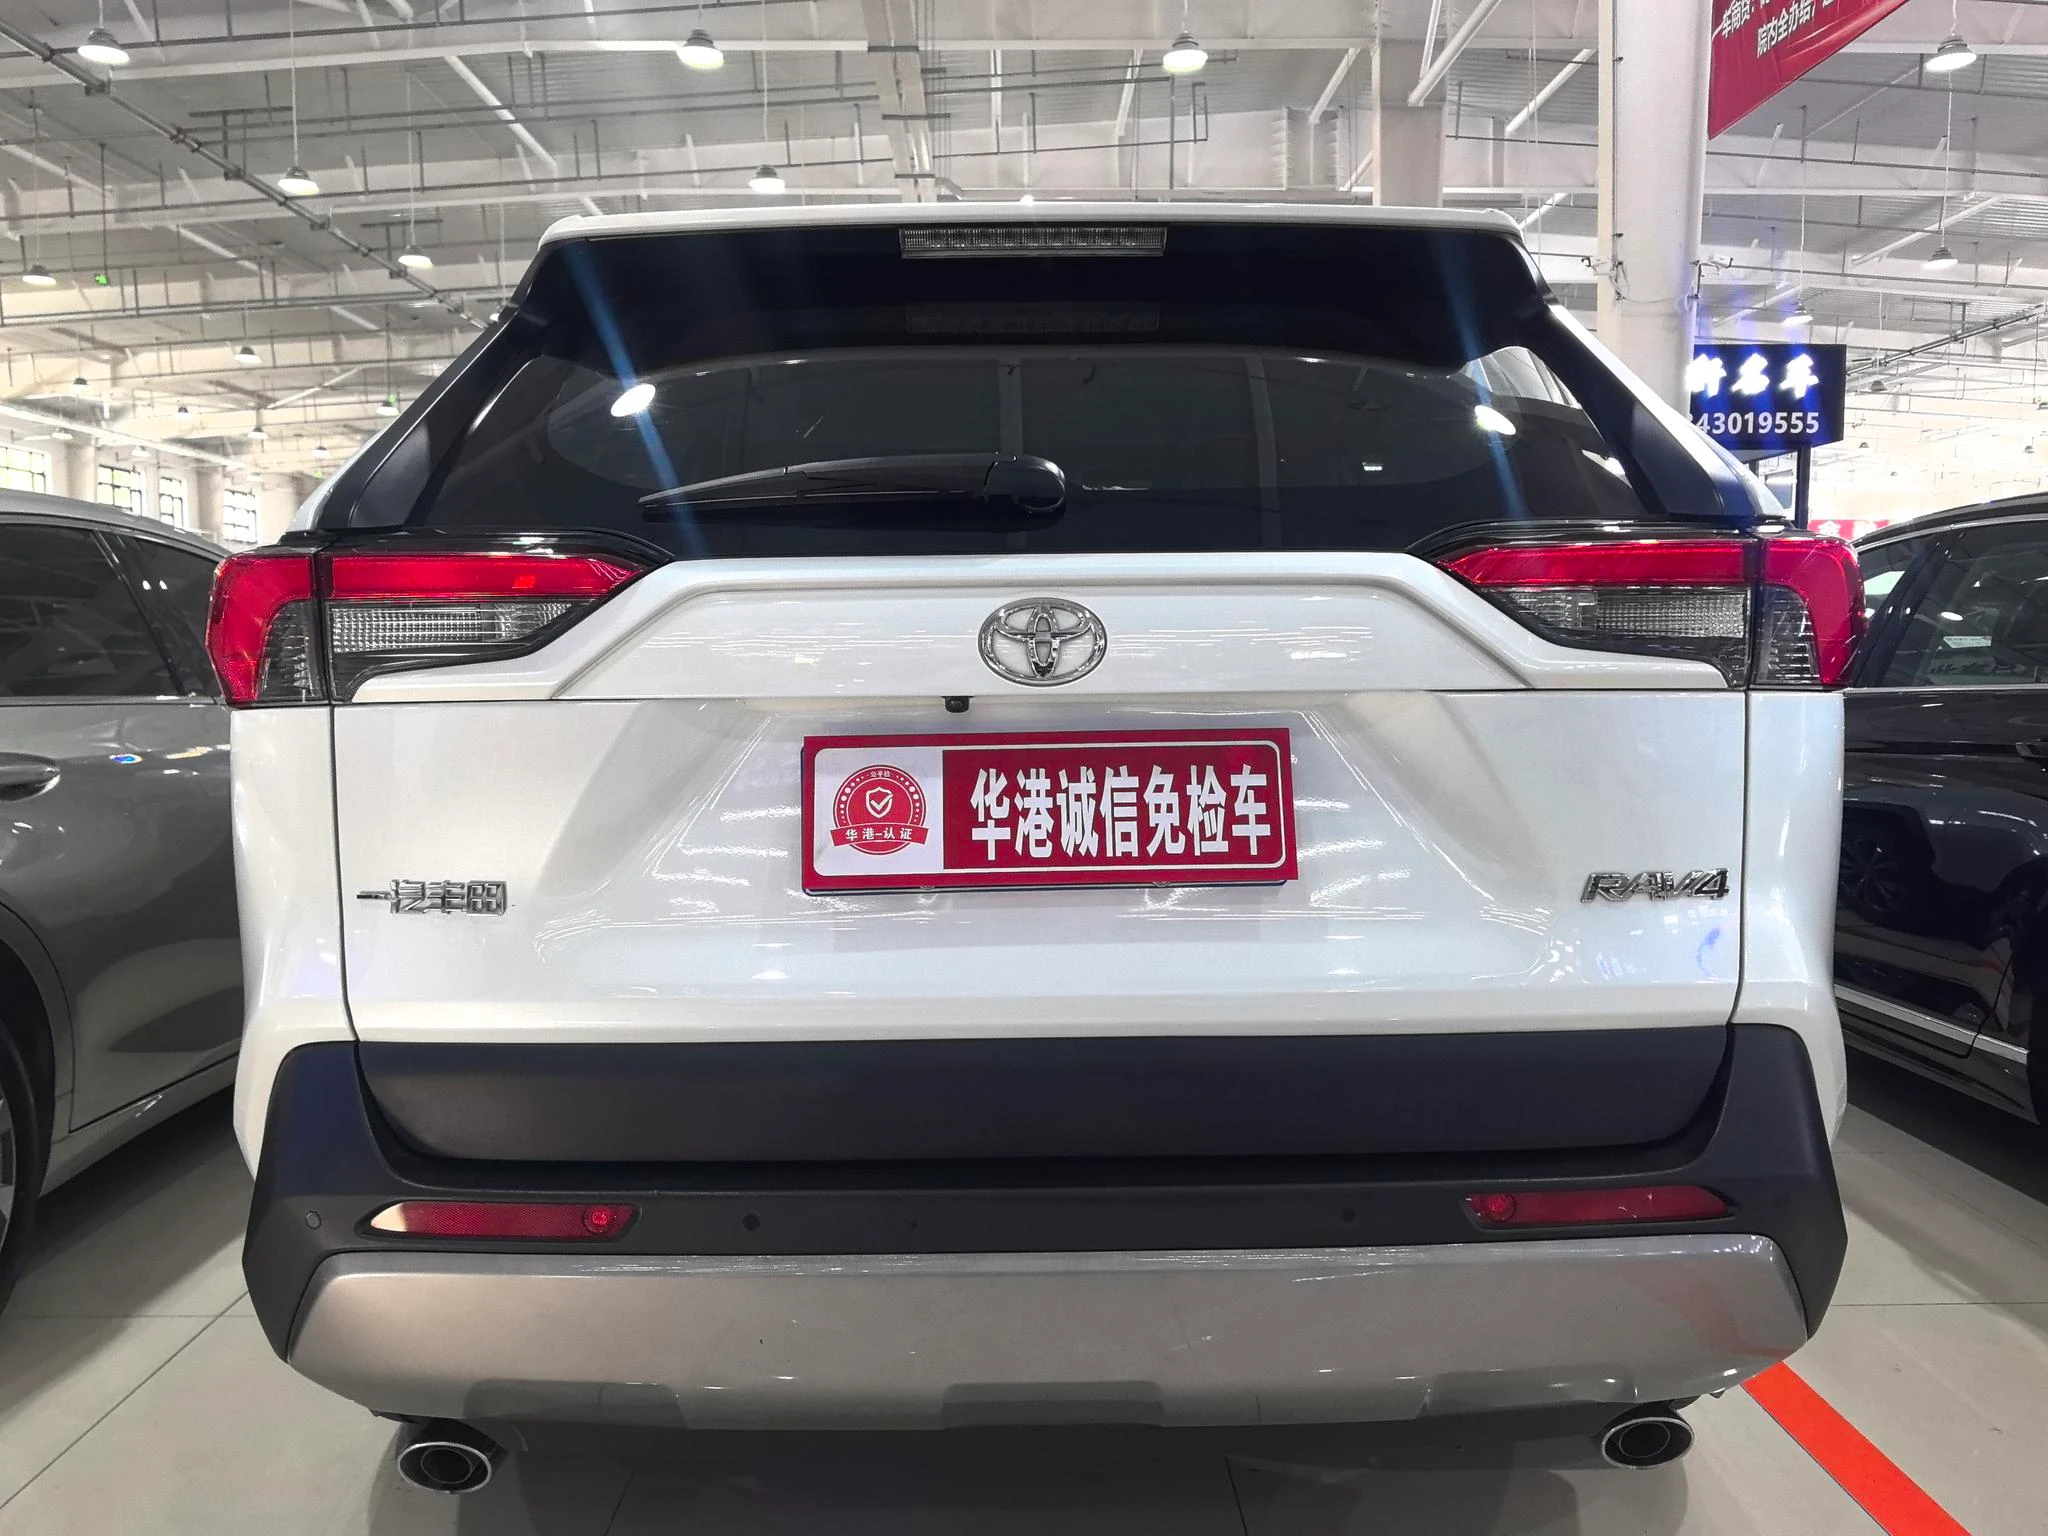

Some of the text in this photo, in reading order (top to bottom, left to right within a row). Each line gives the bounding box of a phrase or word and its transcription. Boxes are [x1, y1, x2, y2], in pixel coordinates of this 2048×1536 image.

[1687, 412, 1819, 434] 43019555
[970, 765, 1271, 861] 华港诚信免检车
[356, 879, 508, 917] 一汽丰田
[1580, 867, 1730, 903] RAV4
